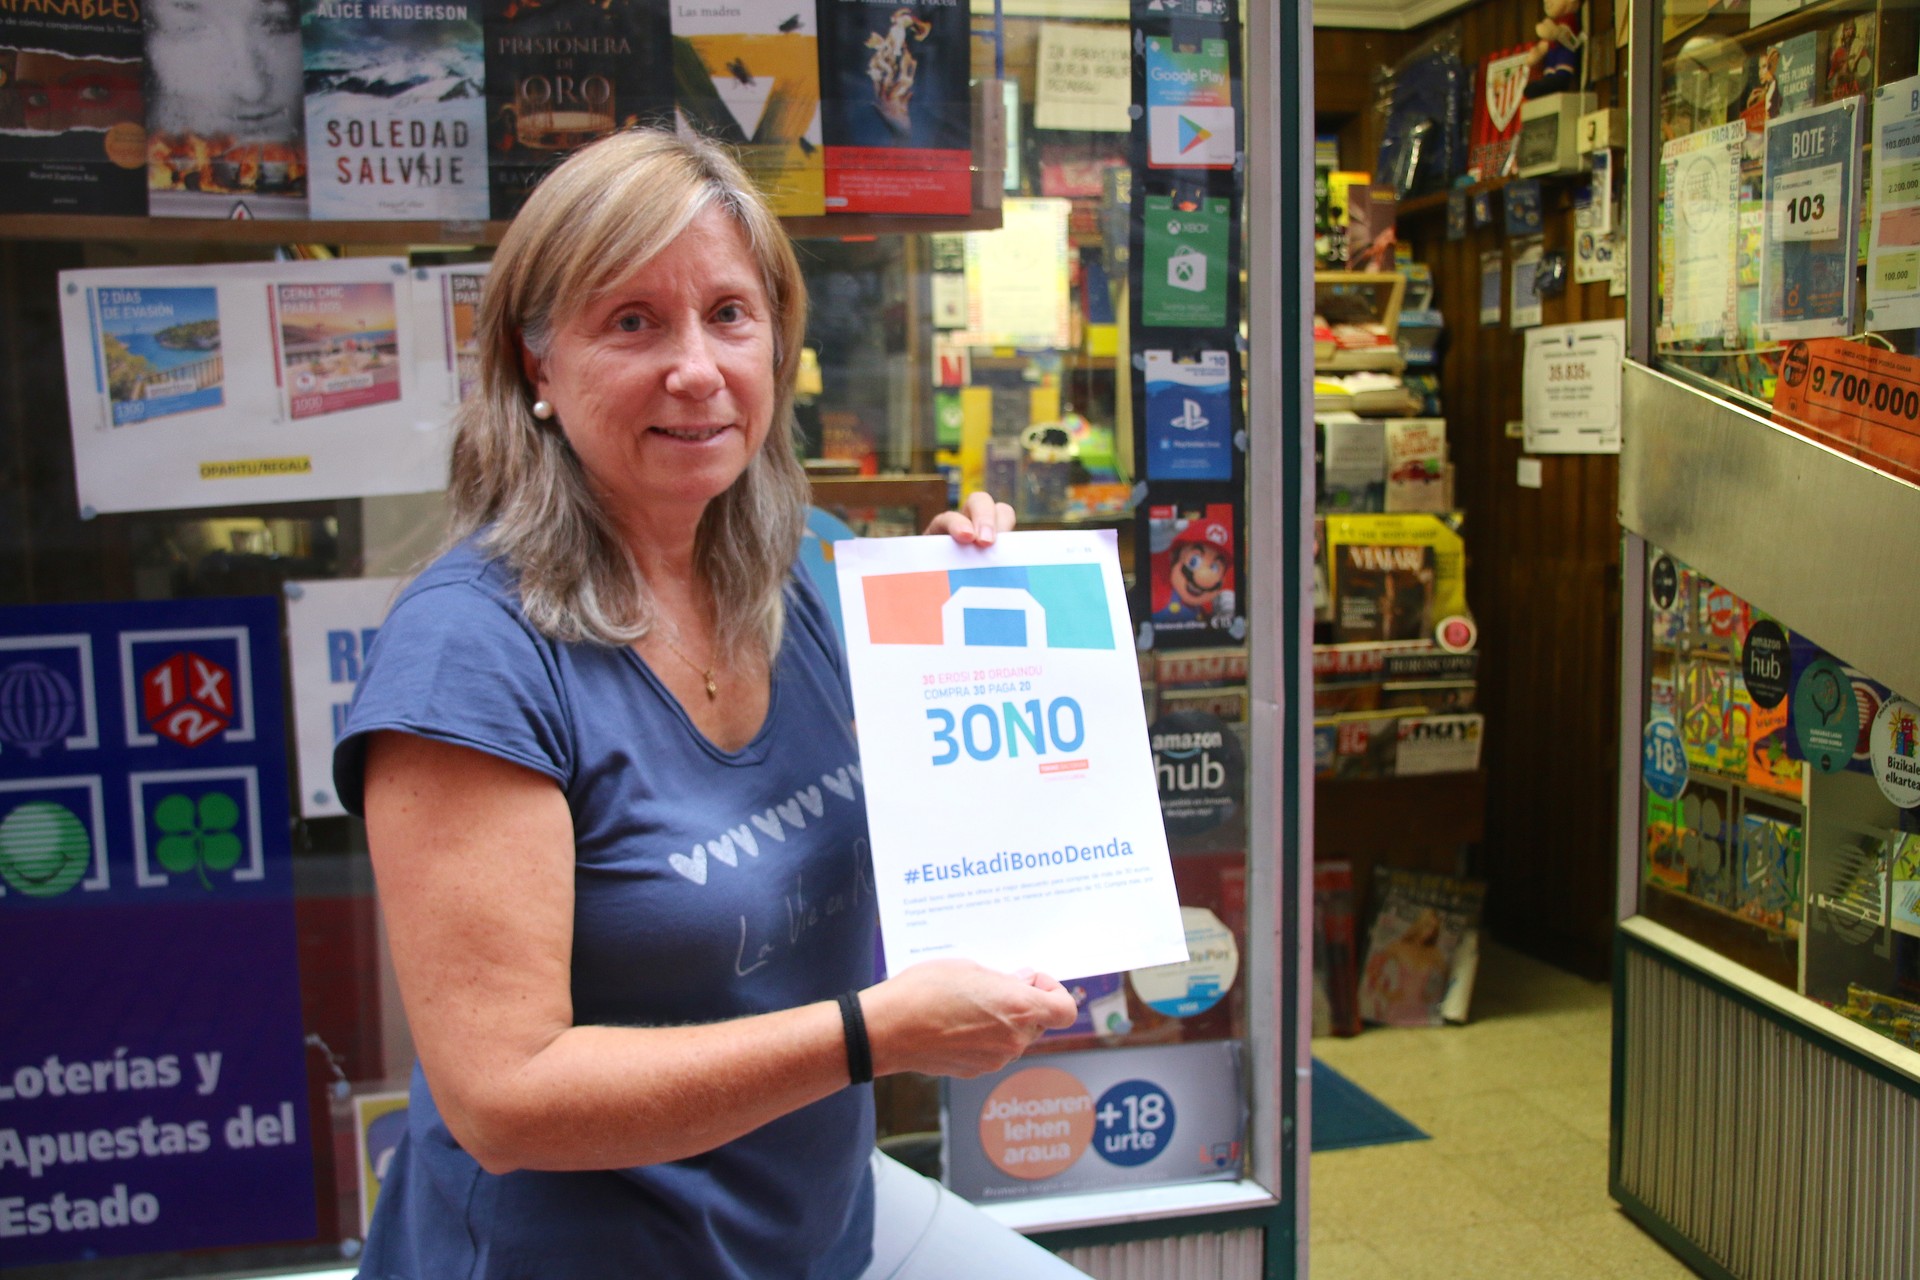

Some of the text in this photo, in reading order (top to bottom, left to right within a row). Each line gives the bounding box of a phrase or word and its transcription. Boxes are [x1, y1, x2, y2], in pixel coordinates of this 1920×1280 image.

[317, 3, 468, 21] ALICE HENDERSON
[677, 5, 741, 18] Las madres
[499, 37, 631, 55] PRISIONERA
[1151, 67, 1225, 86] Google Play
[522, 74, 611, 105] ORO
[327, 119, 470, 148] SOLEDAD
[1792, 126, 1826, 159] BOTE
[1787, 193, 1826, 224] 103
[101, 289, 142, 305] 2 DÍAS
[281, 287, 314, 299] CENA
[104, 302, 174, 319] DE EVASIÓN
[284, 303, 316, 314] PARA
[1811, 365, 1919, 420] 9.700.000
[1751, 636, 1781, 651] amazon
[922, 665, 1043, 685] 30 EROSI 20 ORDAINDU
[1750, 650, 1781, 679] hub
[153, 659, 226, 742] 1 X 2
[924, 680, 1032, 700] COMPRA 30 PAGA 20
[1152, 732, 1223, 751] amazon
[1153, 752, 1226, 792] hub
[904, 836, 1133, 885] #EuskadiBonoDenda
[194, 1051, 223, 1096] y
[983, 1093, 1095, 1122] Jokoaren
[1097, 1092, 1166, 1132] +18
[0, 1102, 297, 1178] Apuestas del
[1003, 1118, 1071, 1142] lehen
[1104, 1130, 1157, 1154] urte
[1002, 1144, 1071, 1165] araua
[0, 1183, 161, 1237] Estado
